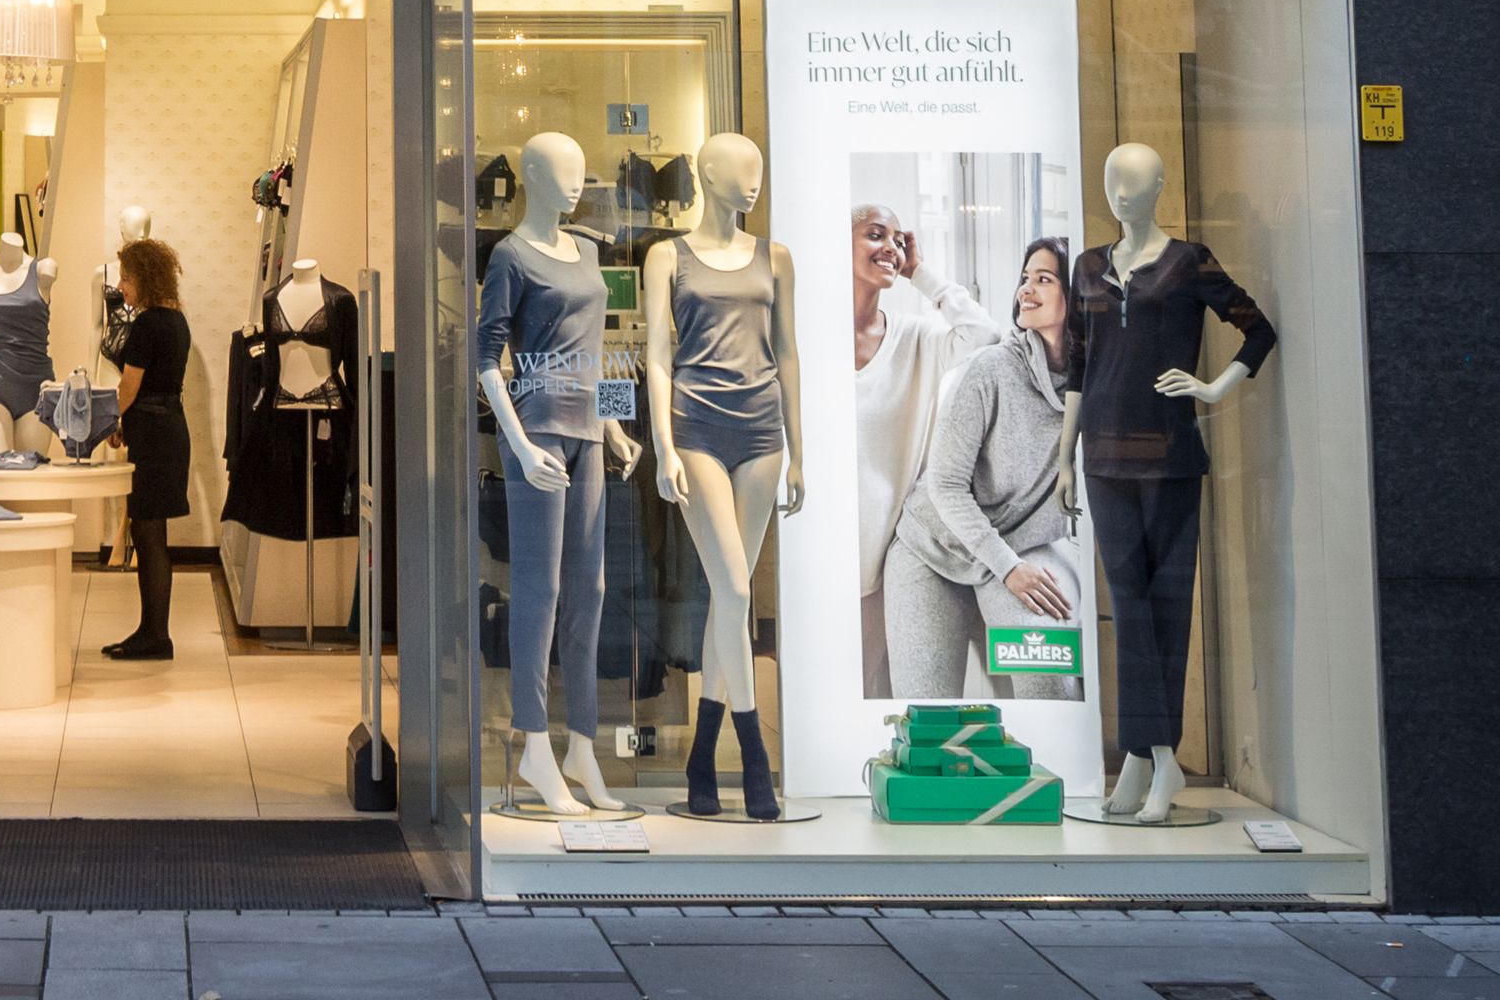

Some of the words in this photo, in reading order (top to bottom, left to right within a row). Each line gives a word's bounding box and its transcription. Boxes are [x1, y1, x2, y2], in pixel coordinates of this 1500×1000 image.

[807, 31, 857, 54] Eine
[860, 29, 920, 55] Welt,
[924, 29, 961, 54] die
[965, 29, 1012, 54] sich
[807, 61, 887, 83] immer
[890, 62, 930, 89] gut
[934, 58, 1025, 84] anfühlt.
[1365, 92, 1380, 103] KH
[847, 100, 877, 114] Eine
[879, 100, 914, 115] Welt,
[916, 100, 938, 114] die
[940, 101, 982, 115] passt.
[1374, 125, 1395, 138] 119
[515, 350, 641, 374] WINDOW
[997, 644, 1073, 661] PALMERS
